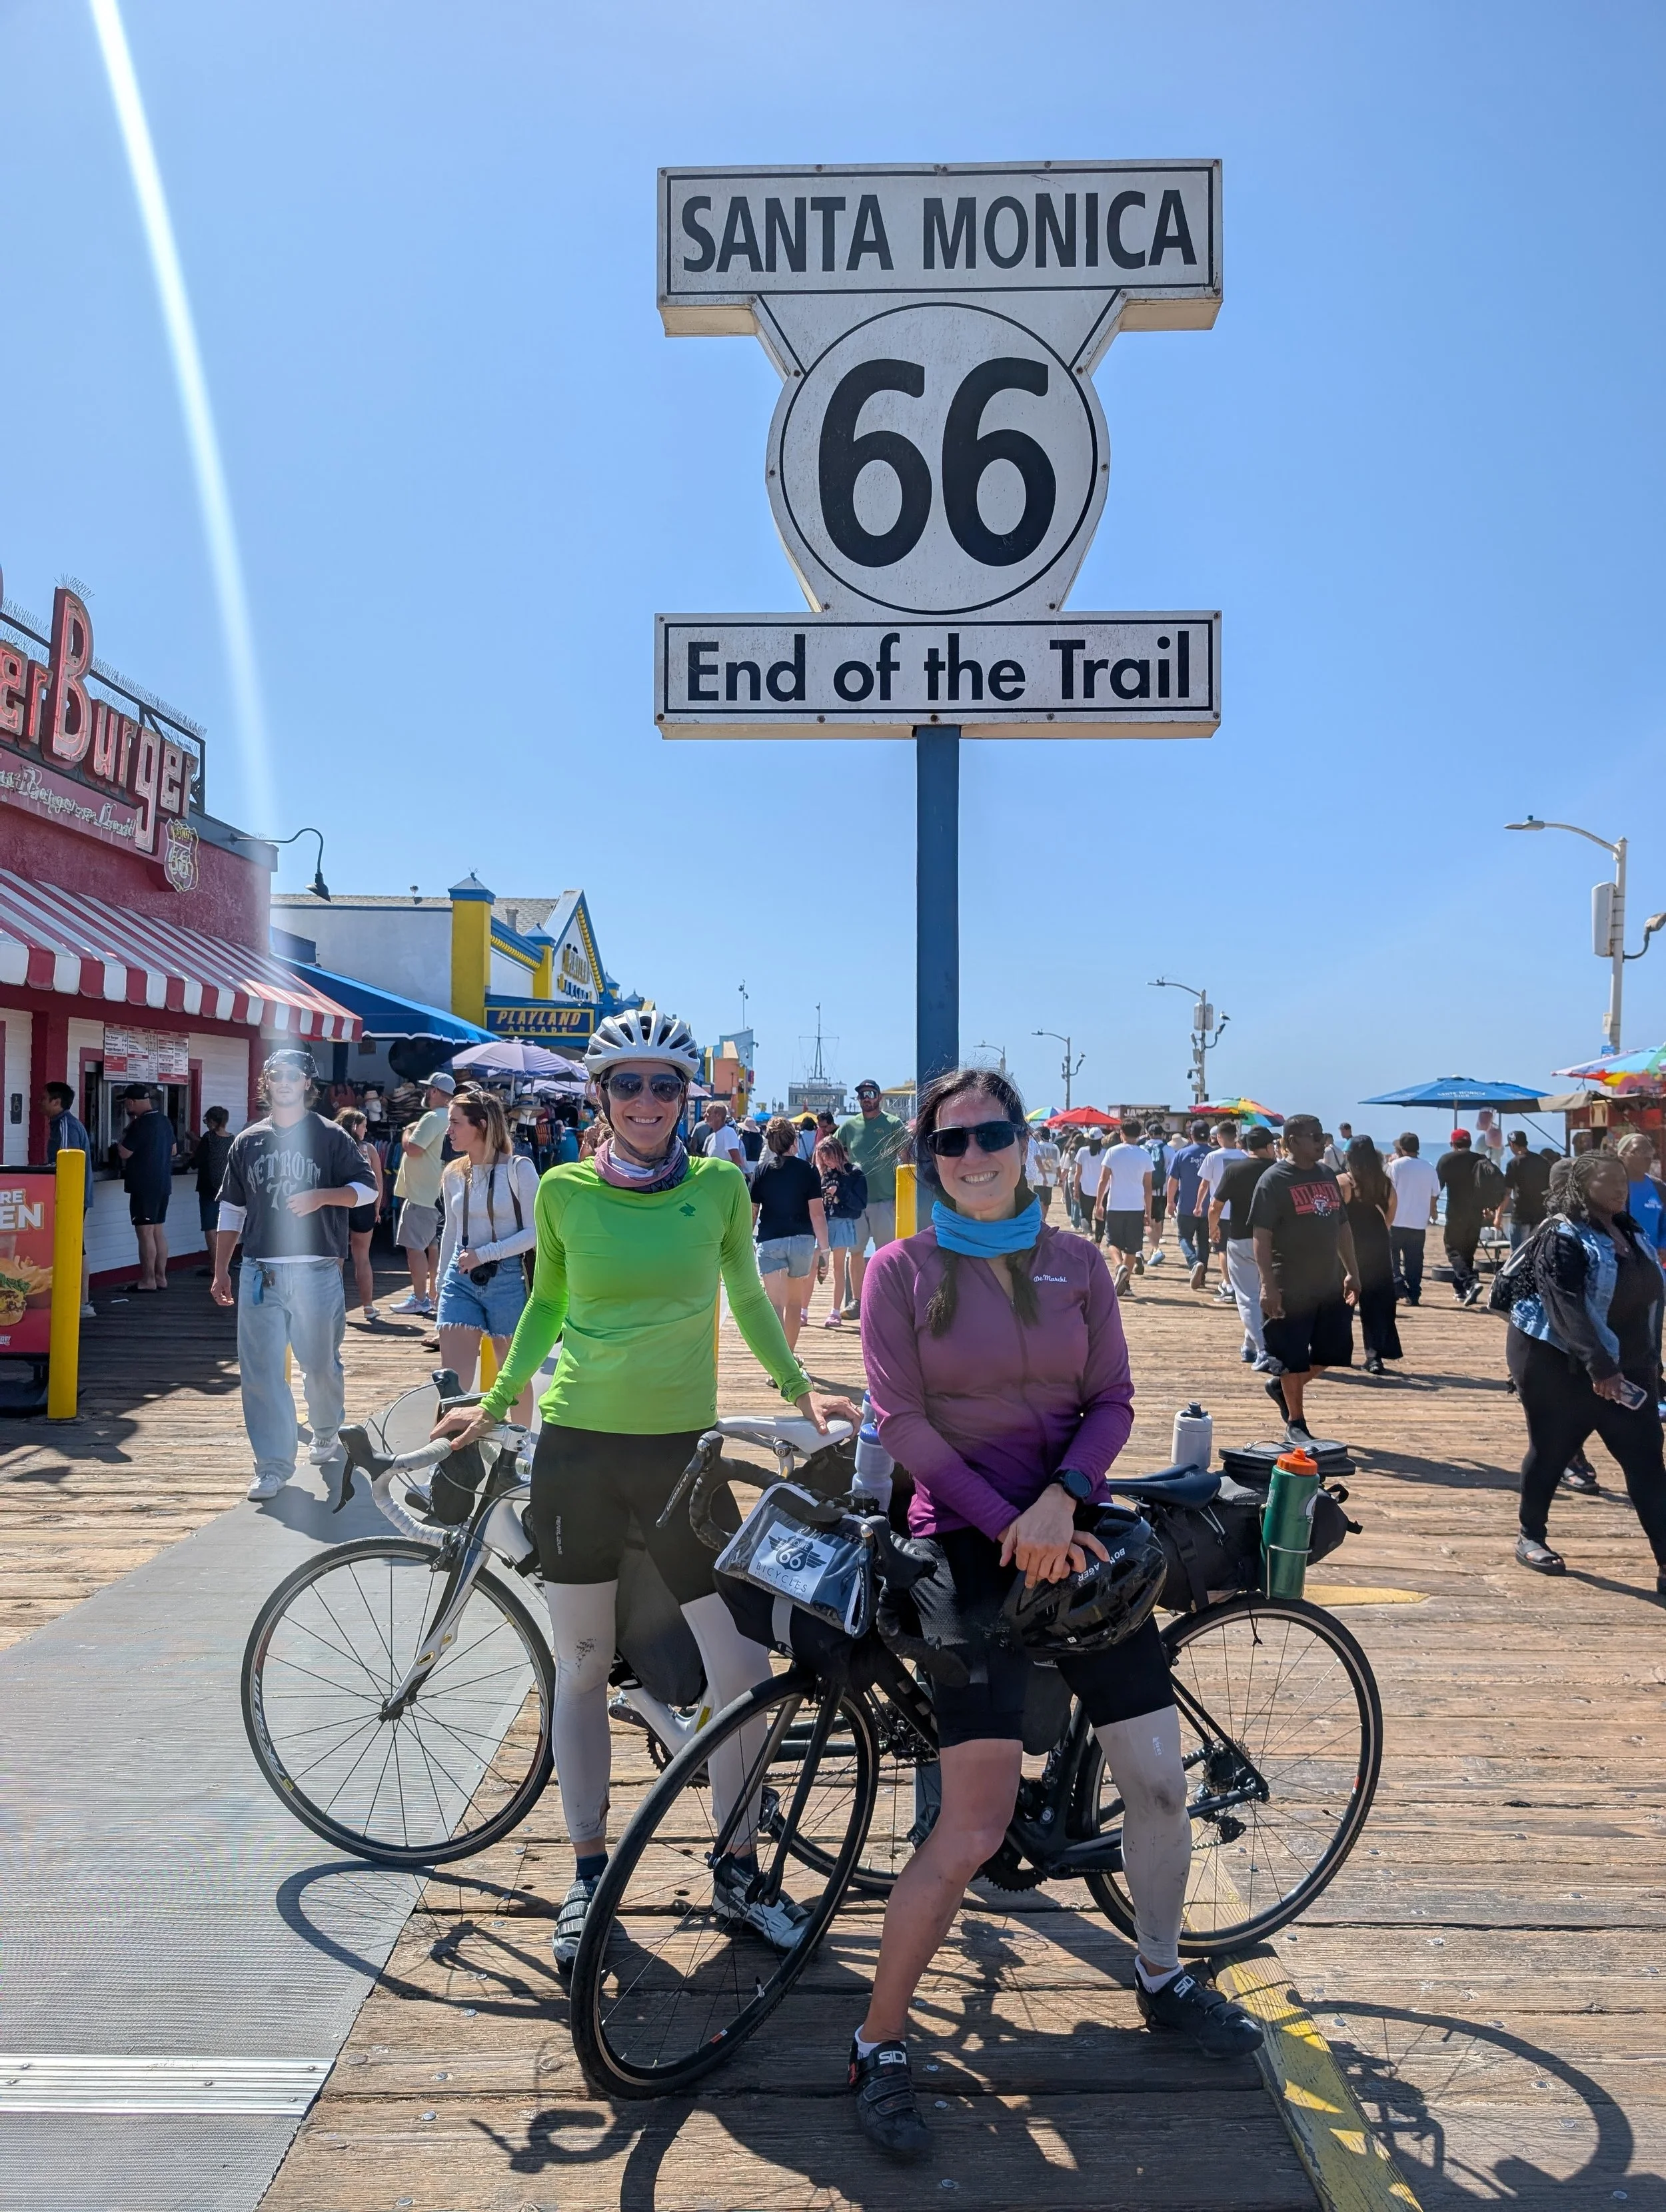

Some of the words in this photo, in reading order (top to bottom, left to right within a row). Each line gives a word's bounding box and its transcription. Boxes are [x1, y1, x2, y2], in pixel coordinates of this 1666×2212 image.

[682, 195, 894, 273] SANTA
[923, 190, 1197, 270] MONICA
[818, 357, 1057, 568] 66
[687, 634, 806, 702] End
[833, 633, 900, 702] of
[924, 633, 1026, 701] the
[1050, 631, 1190, 700] Trail
[496, 1010, 582, 1026] PLAYLAND
[1289, 1183, 1340, 1207] ATLANTA
[1043, 1274, 1068, 1283] Marchi
[779, 1549, 804, 1568] 66
[1078, 1547, 1126, 1582] BONAGER
[756, 1562, 808, 1592] BICYCLES
